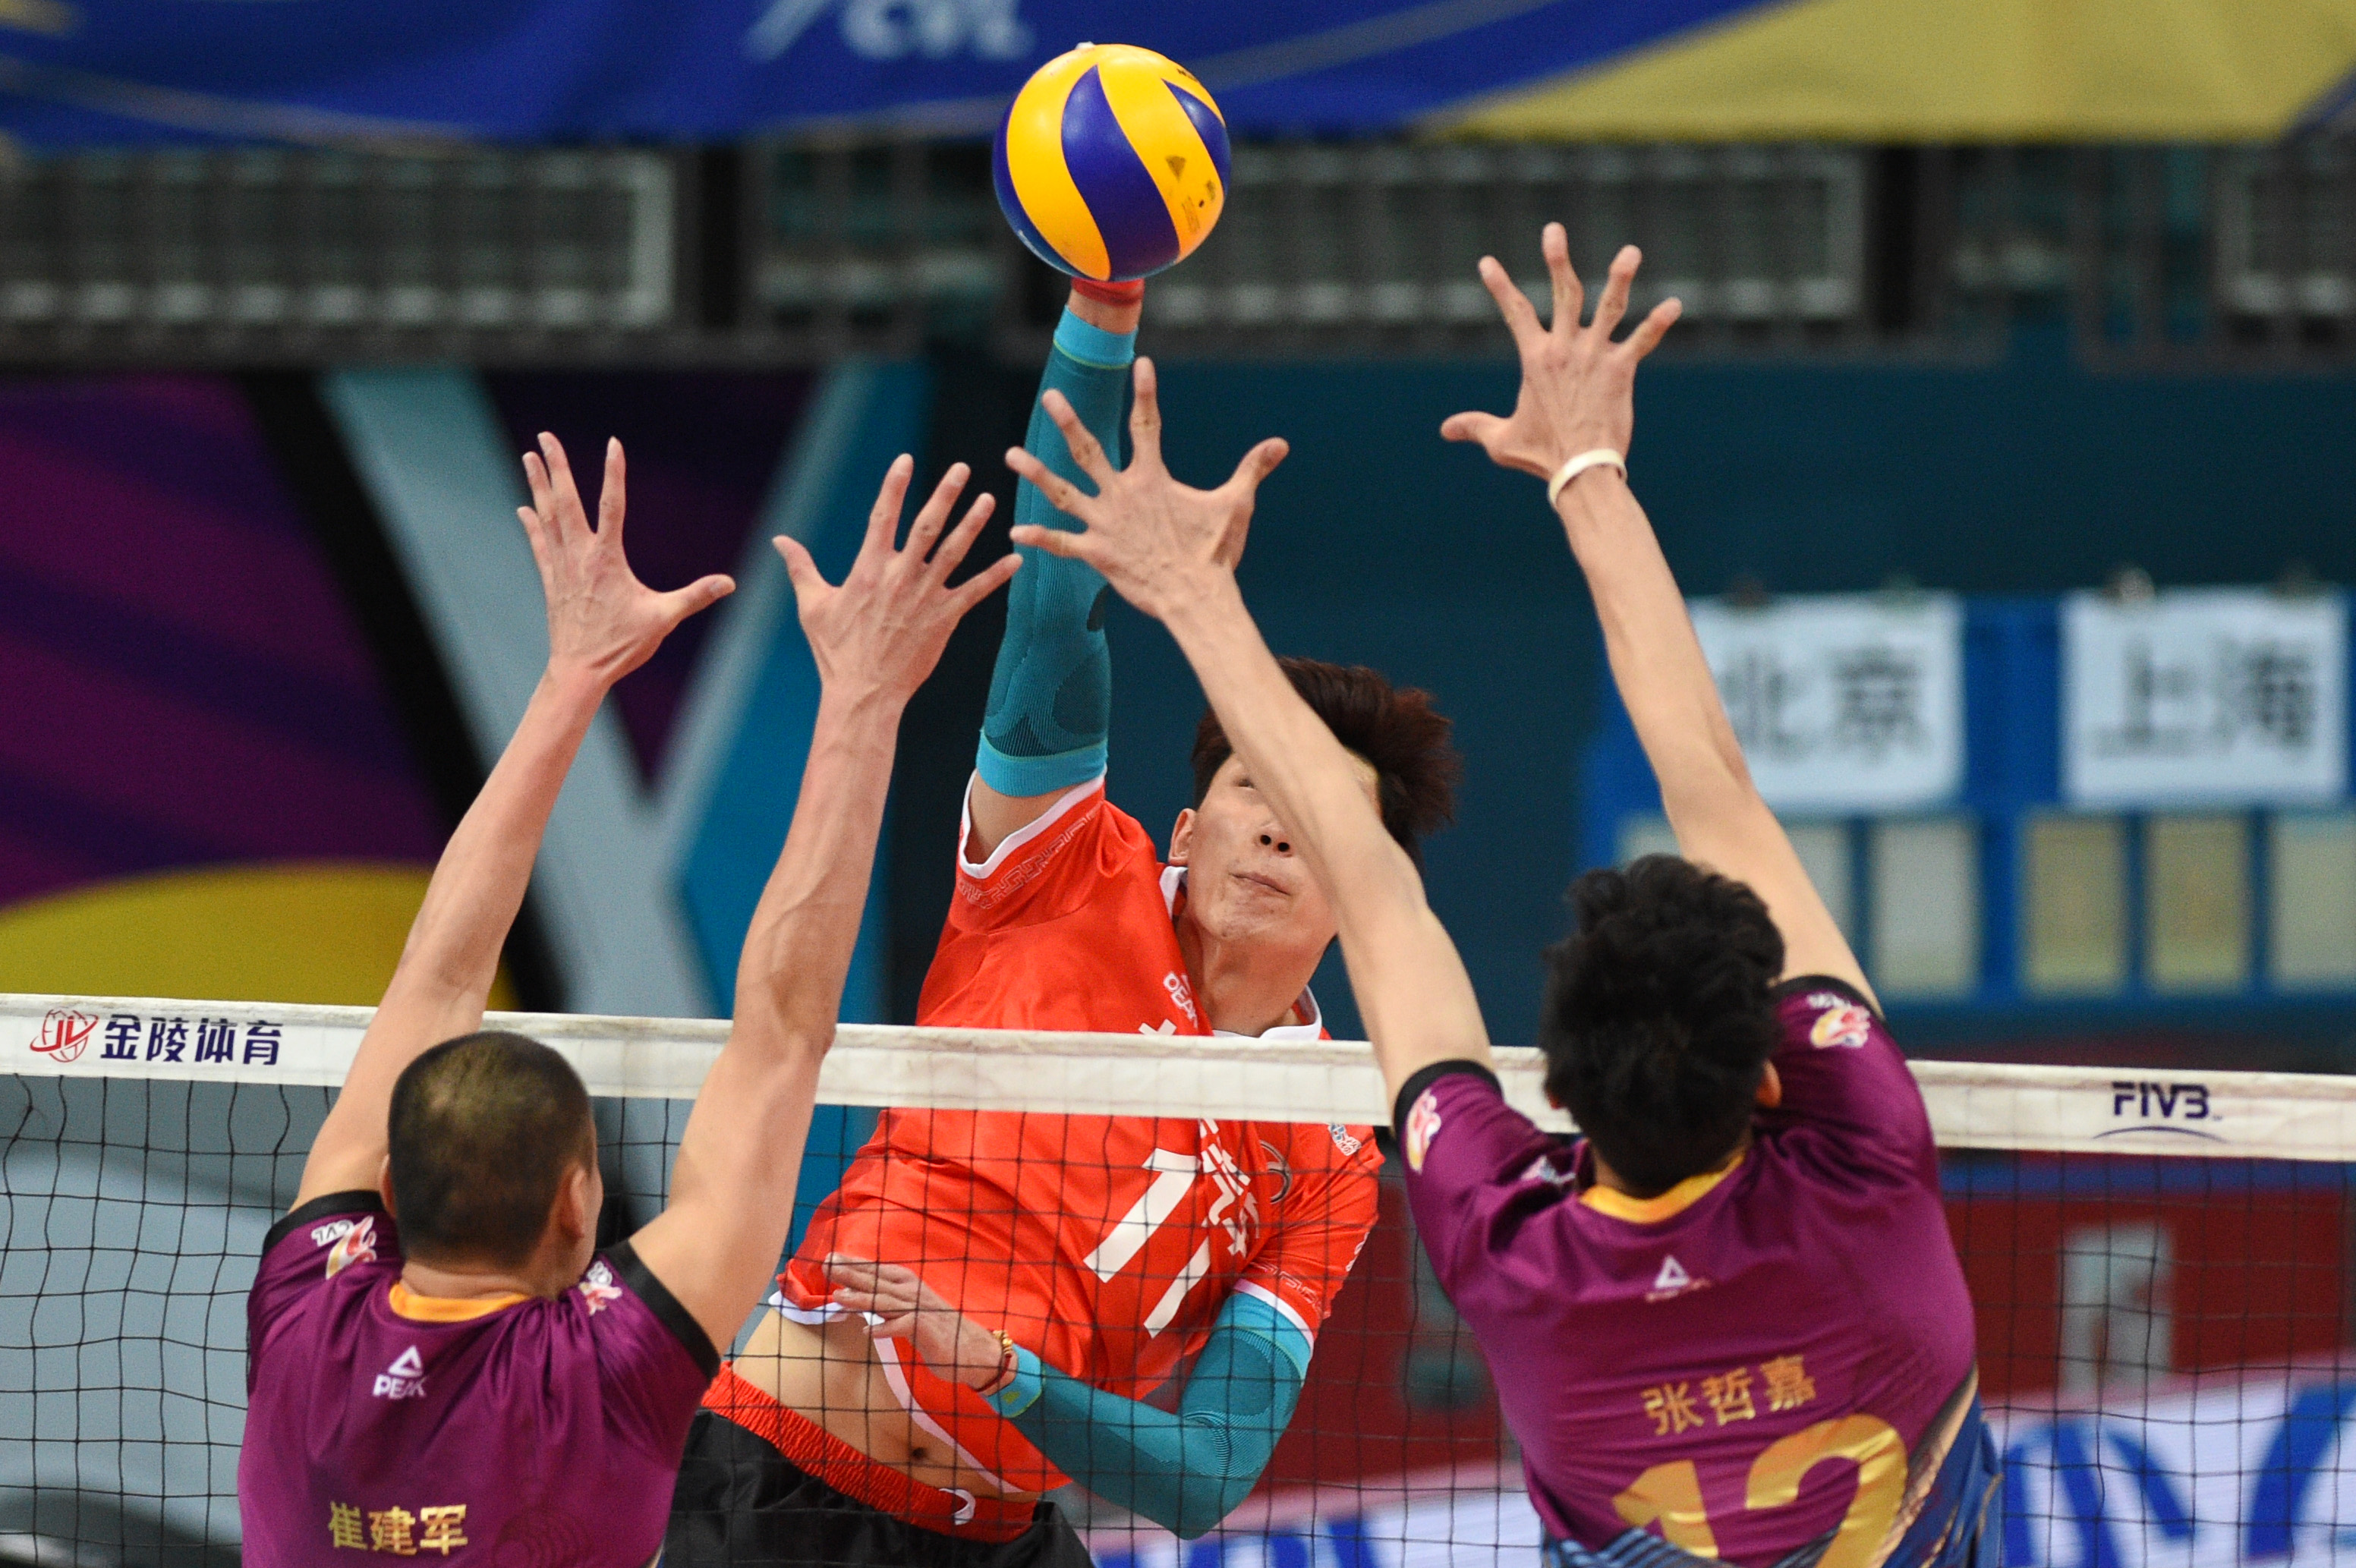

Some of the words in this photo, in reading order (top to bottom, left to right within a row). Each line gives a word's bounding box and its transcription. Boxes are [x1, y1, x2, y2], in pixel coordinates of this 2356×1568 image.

[2093, 636, 2317, 760] 上海
[100, 1013, 284, 1066] 金陵体育
[2112, 1080, 2209, 1119] FIVB
[373, 1374, 427, 1400] PEAK
[1640, 1355, 1816, 1436] 张哲嘉
[328, 1500, 468, 1557] 崔建军
